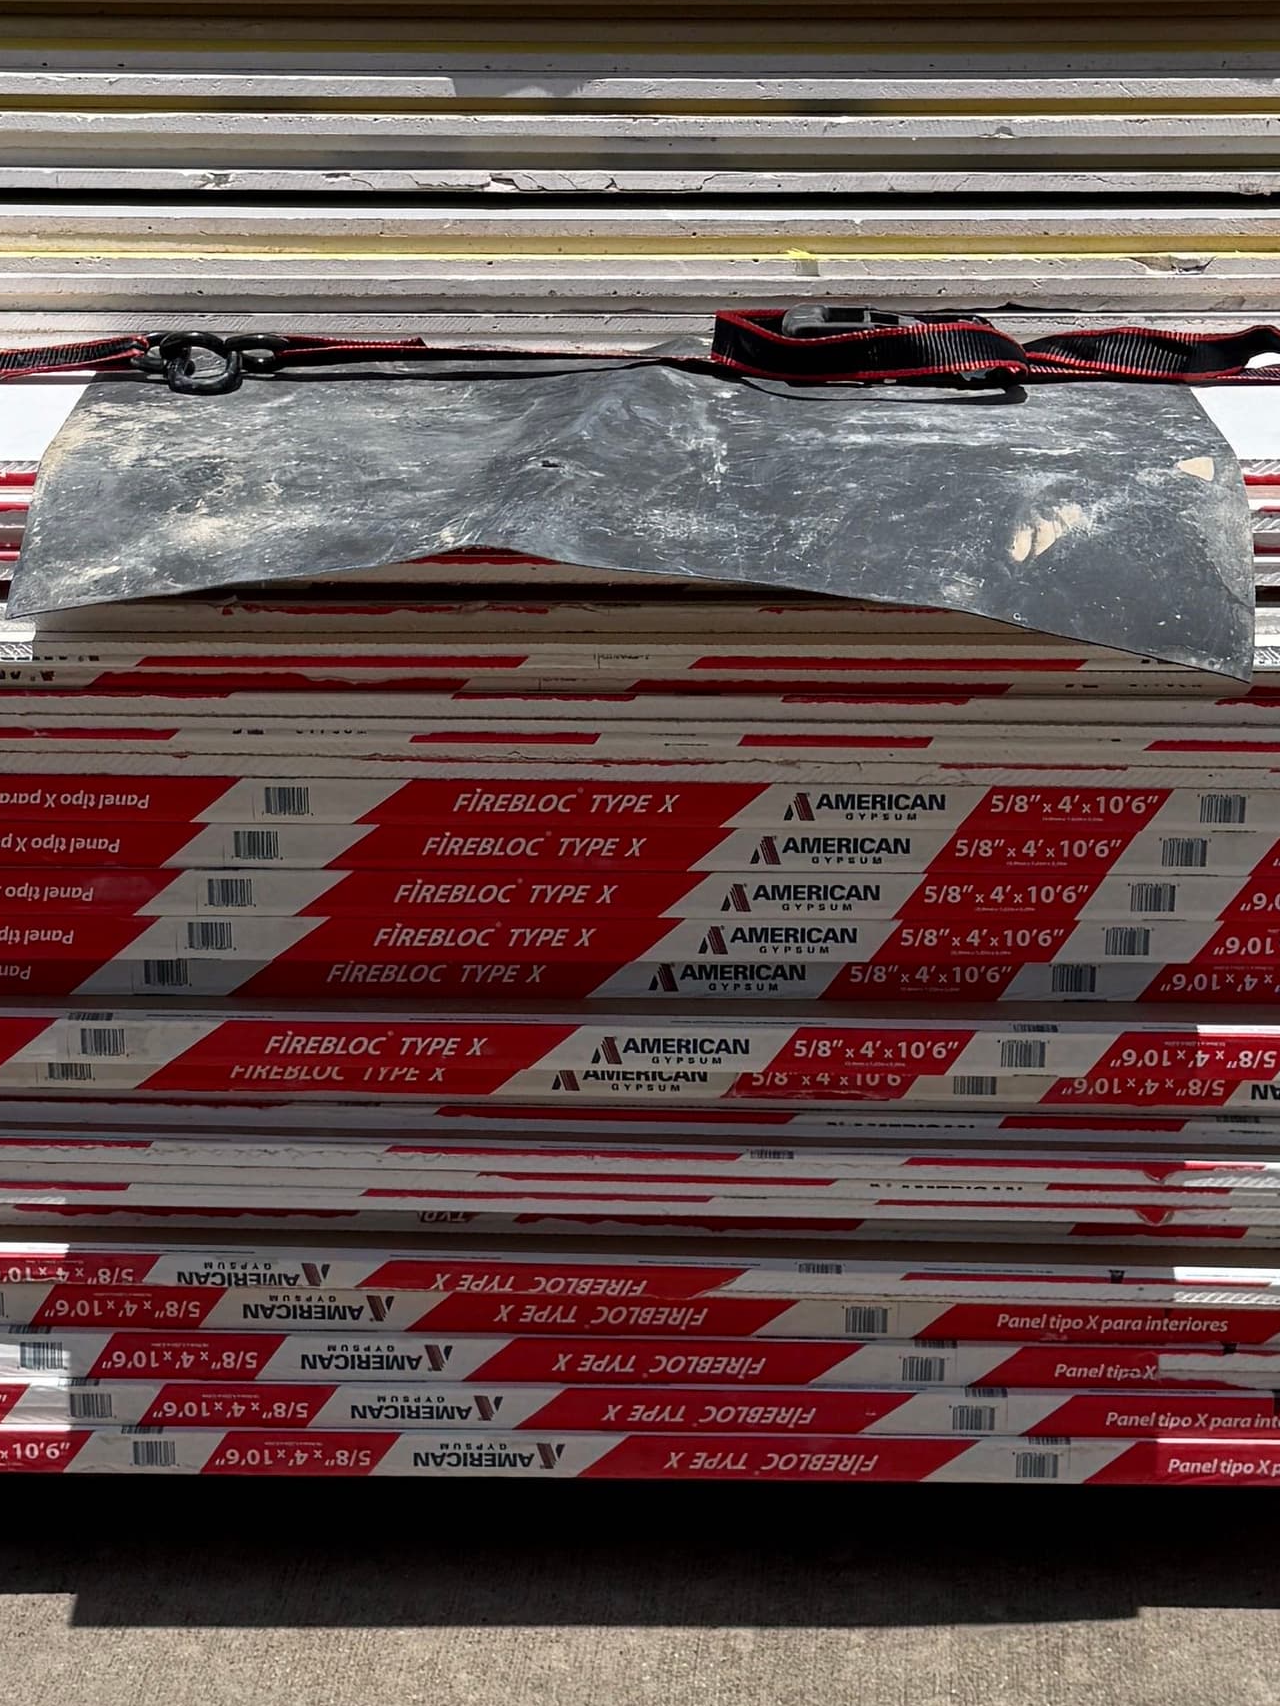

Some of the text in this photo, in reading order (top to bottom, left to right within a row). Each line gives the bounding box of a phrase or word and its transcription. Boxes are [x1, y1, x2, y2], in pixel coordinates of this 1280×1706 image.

[0, 789, 42, 804] para
[44, 793, 57, 808] X
[60, 790, 95, 809] tipo
[98, 794, 150, 809] Panel
[453, 788, 680, 813] FIREBLOC TYPE X
[816, 794, 946, 811] AMERICAN
[1043, 803, 1052, 813] x
[1082, 803, 1091, 813] x
[845, 812, 917, 821] GYPSUM
[782, 837, 910, 854] AMERICAN
[811, 856, 882, 864] GYPSUM
[394, 879, 618, 904] FIREBLOC TYPE X
[24, 930, 74, 945] Panel
[374, 923, 596, 947] FIREBLOC TYPE X
[730, 927, 857, 944] AMERICAN
[759, 945, 829, 954] GYPSUM
[265, 1031, 488, 1056] FIREBLOC TYPE X
[622, 1038, 750, 1055] AMERICAN
[652, 1056, 722, 1064] GYPSUM
[845, 1048, 854, 1058] x
[884, 1049, 893, 1058] x
[269, 1295, 336, 1303] GYPSUM
[243, 1304, 364, 1321] AMERICAN
[493, 1304, 708, 1330] FIREBLOC TYPE X
[997, 1314, 1228, 1333] Panel tipo X para interiores
[552, 1354, 766, 1379] FIREBLOC TYPE X
[377, 1395, 445, 1403] GYPSUM
[351, 1405, 472, 1420] AMERICAN
[1106, 1412, 1156, 1426] Panel
[1158, 1412, 1192, 1429] tipo
[1194, 1413, 1208, 1427] X
[1208, 1417, 1249, 1431] para
[277, 1449, 286, 1458] x
[313, 1450, 322, 1458] x
[440, 1443, 507, 1451] GYPSUM
[413, 1452, 535, 1467] AMERICAN
[664, 1452, 879, 1475] FIREBLOC TYPE X
